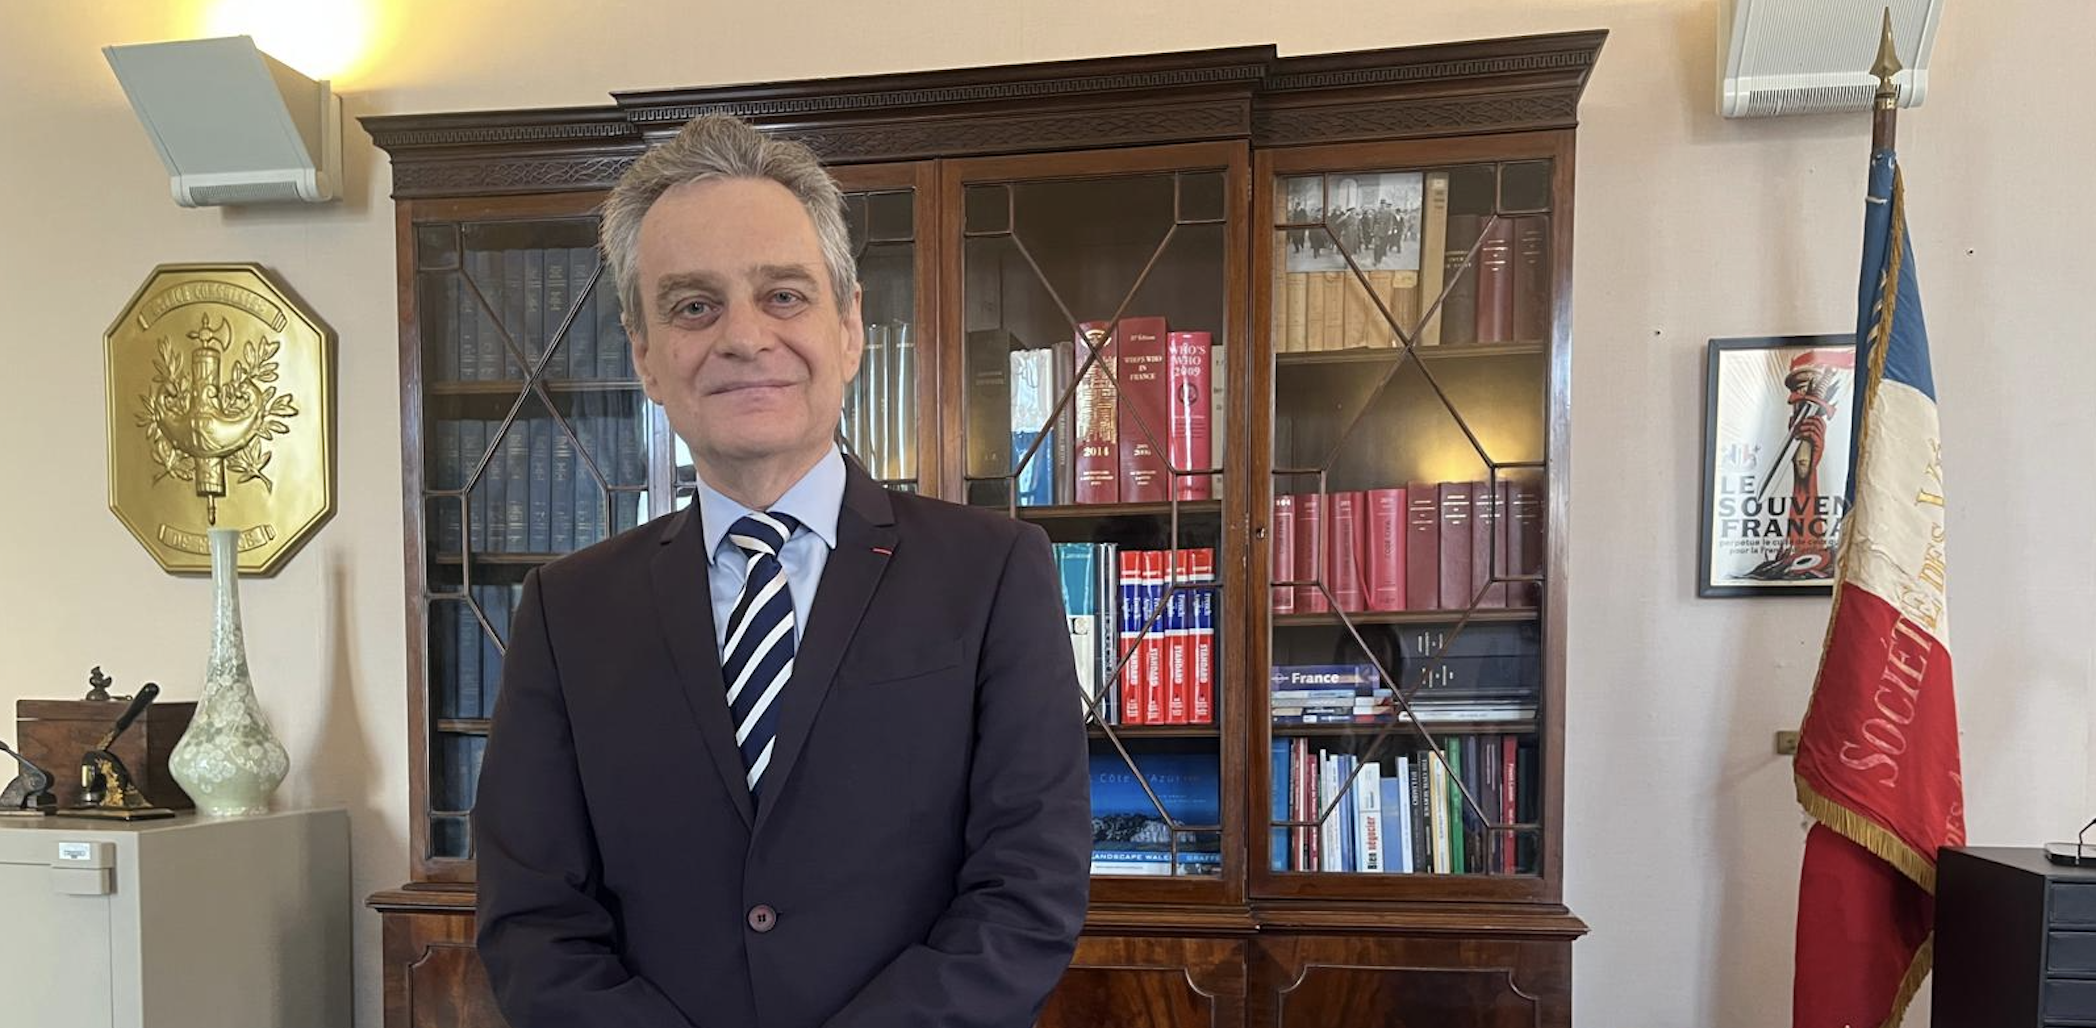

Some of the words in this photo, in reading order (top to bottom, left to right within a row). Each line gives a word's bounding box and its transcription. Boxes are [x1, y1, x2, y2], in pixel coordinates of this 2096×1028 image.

[1169, 343, 1206, 355] WHO'S
[1174, 355, 1202, 366] WHO
[1174, 366, 1202, 377] 2009
[1083, 446, 1110, 457] 2014
[1722, 475, 1755, 494] LE
[1150, 647, 1159, 687] STANDARD
[1174, 645, 1183, 684] STANDARD
[1200, 643, 1208, 683] STANDARD
[1291, 672, 1340, 684] France
[1367, 853, 1377, 870] Bien
